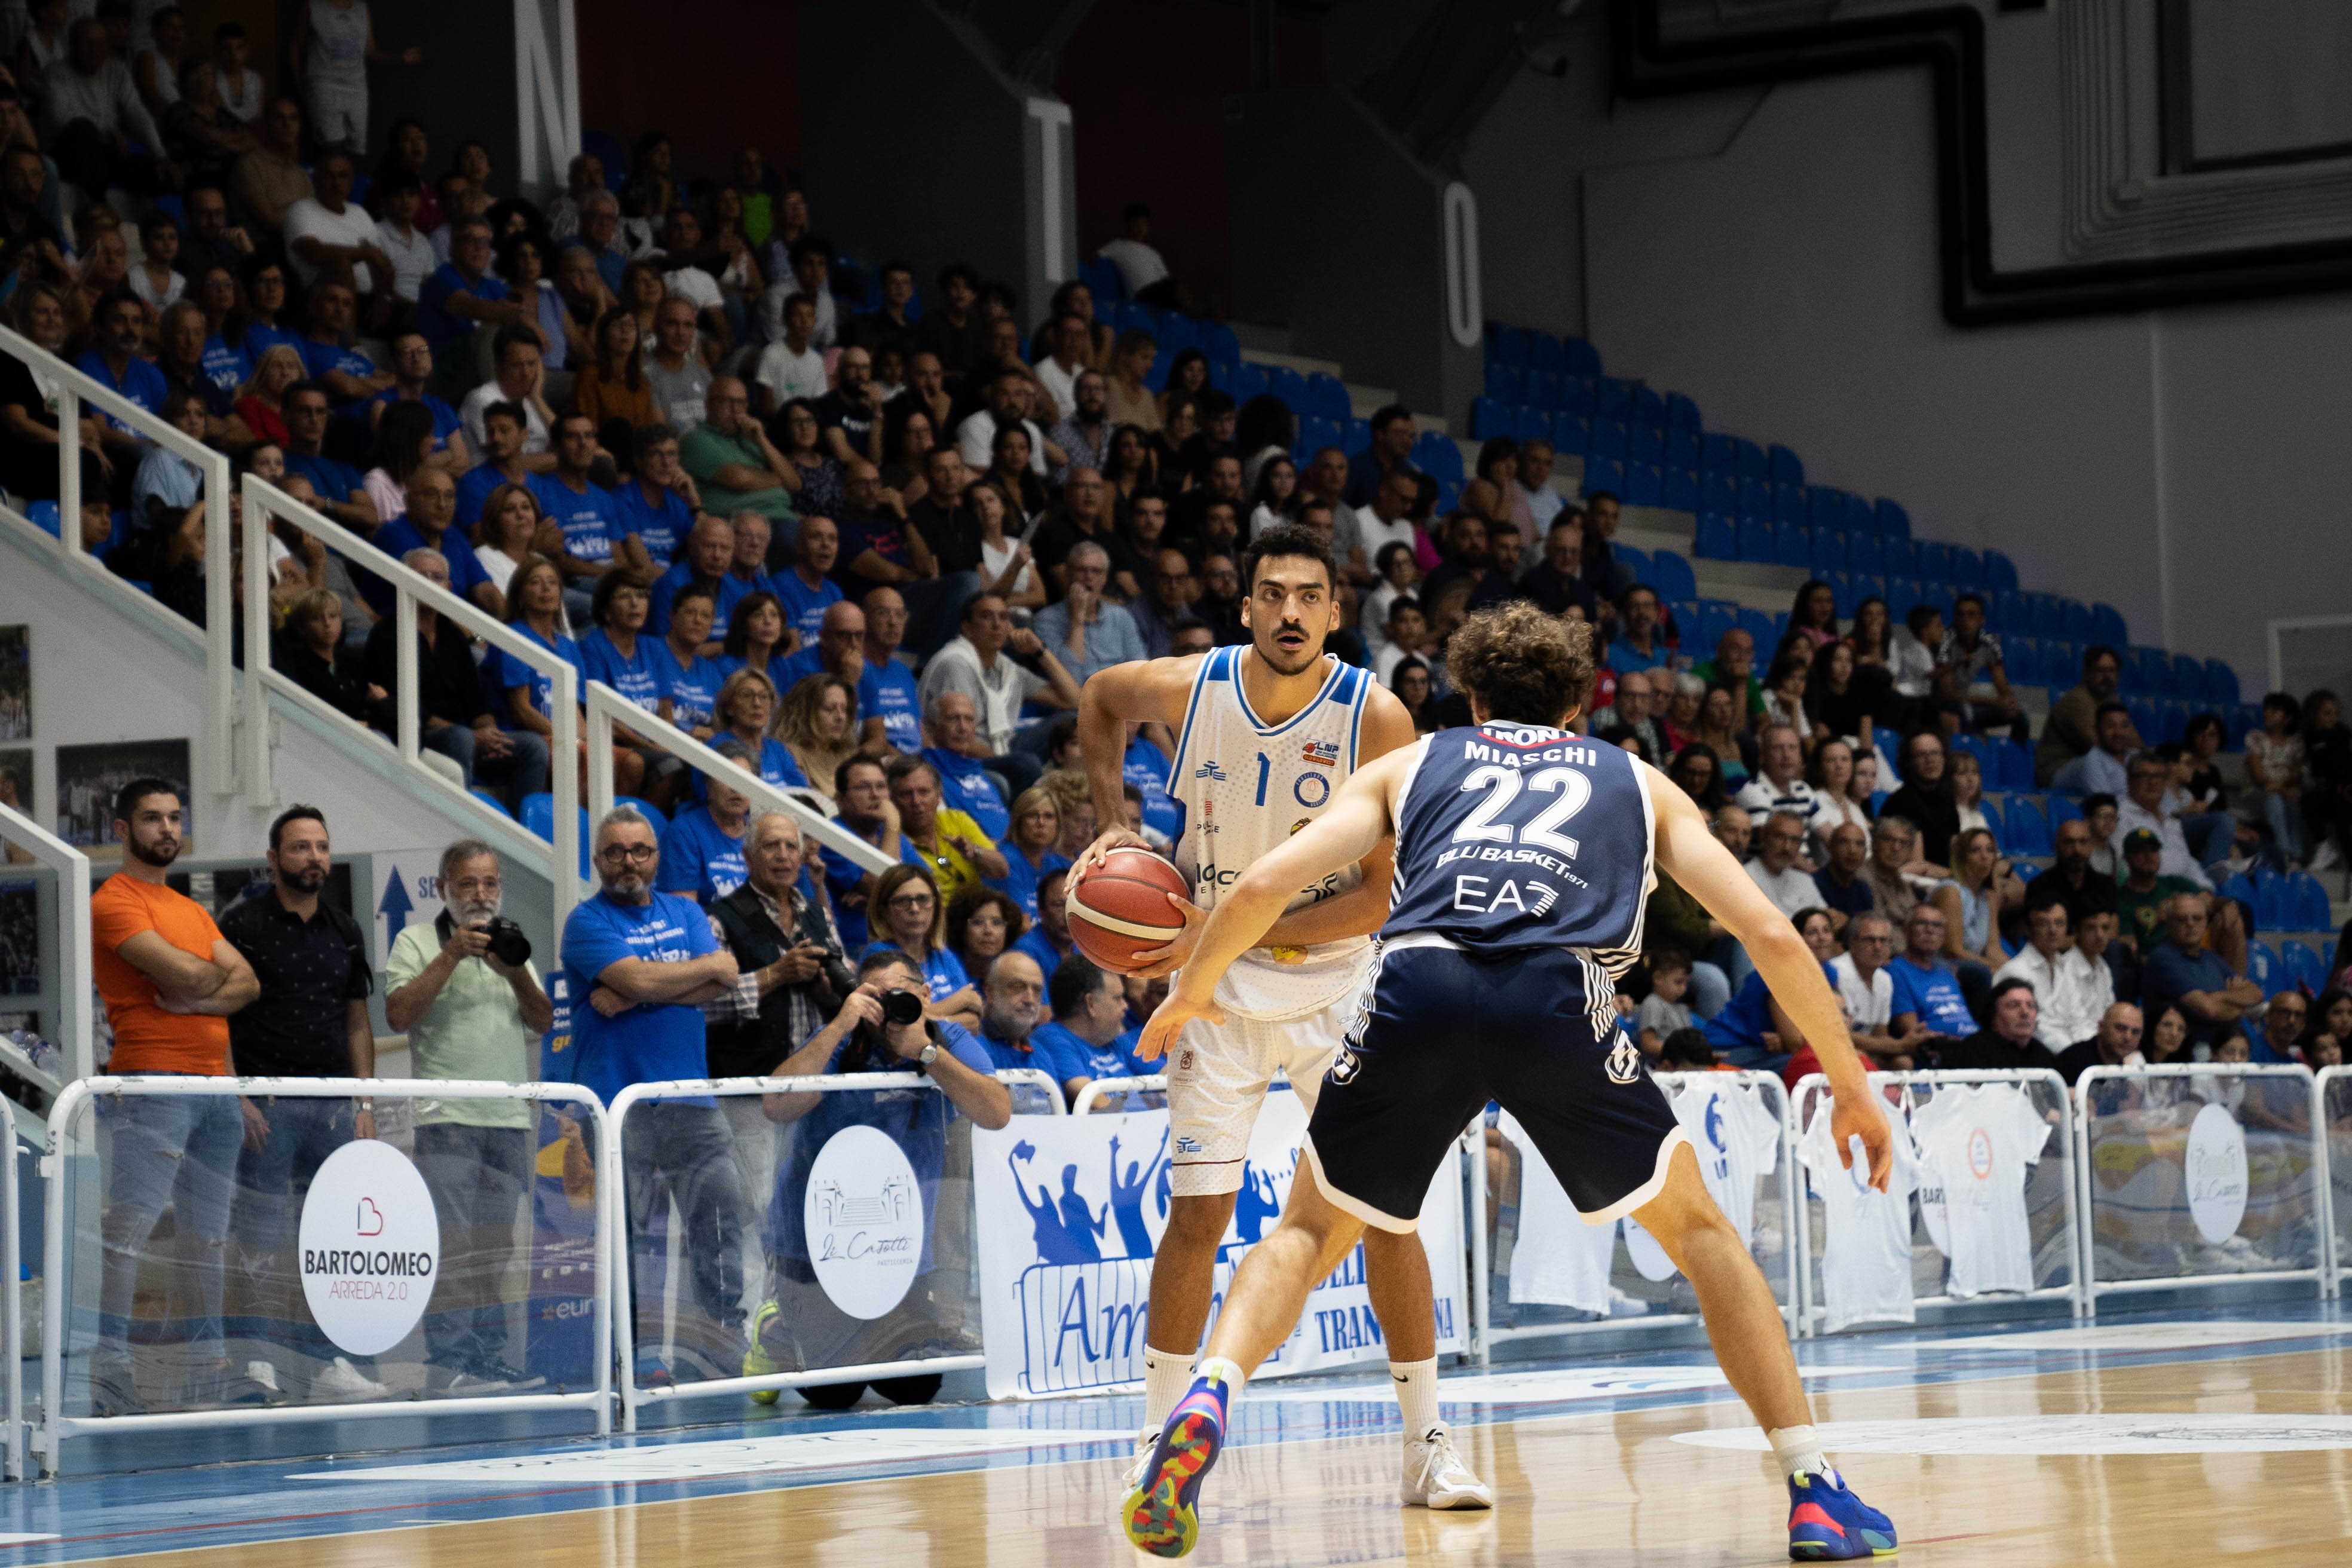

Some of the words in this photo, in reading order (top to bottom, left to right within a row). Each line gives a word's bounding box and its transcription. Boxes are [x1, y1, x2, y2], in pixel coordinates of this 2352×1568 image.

[514, 0, 581, 188] N
[1027, 97, 1072, 283] T
[1464, 740, 1596, 767] MIASCHI
[1255, 752, 1271, 806] 1
[1451, 765, 1592, 860] 22
[1435, 846, 1481, 869] BLU
[1480, 847, 1570, 874] BASKET
[1564, 871, 1589, 889] 1971
[305, 1250, 432, 1276] BARTOLOMEO
[329, 1281, 383, 1299] ARREDA
[387, 1282, 408, 1300] 2.0
